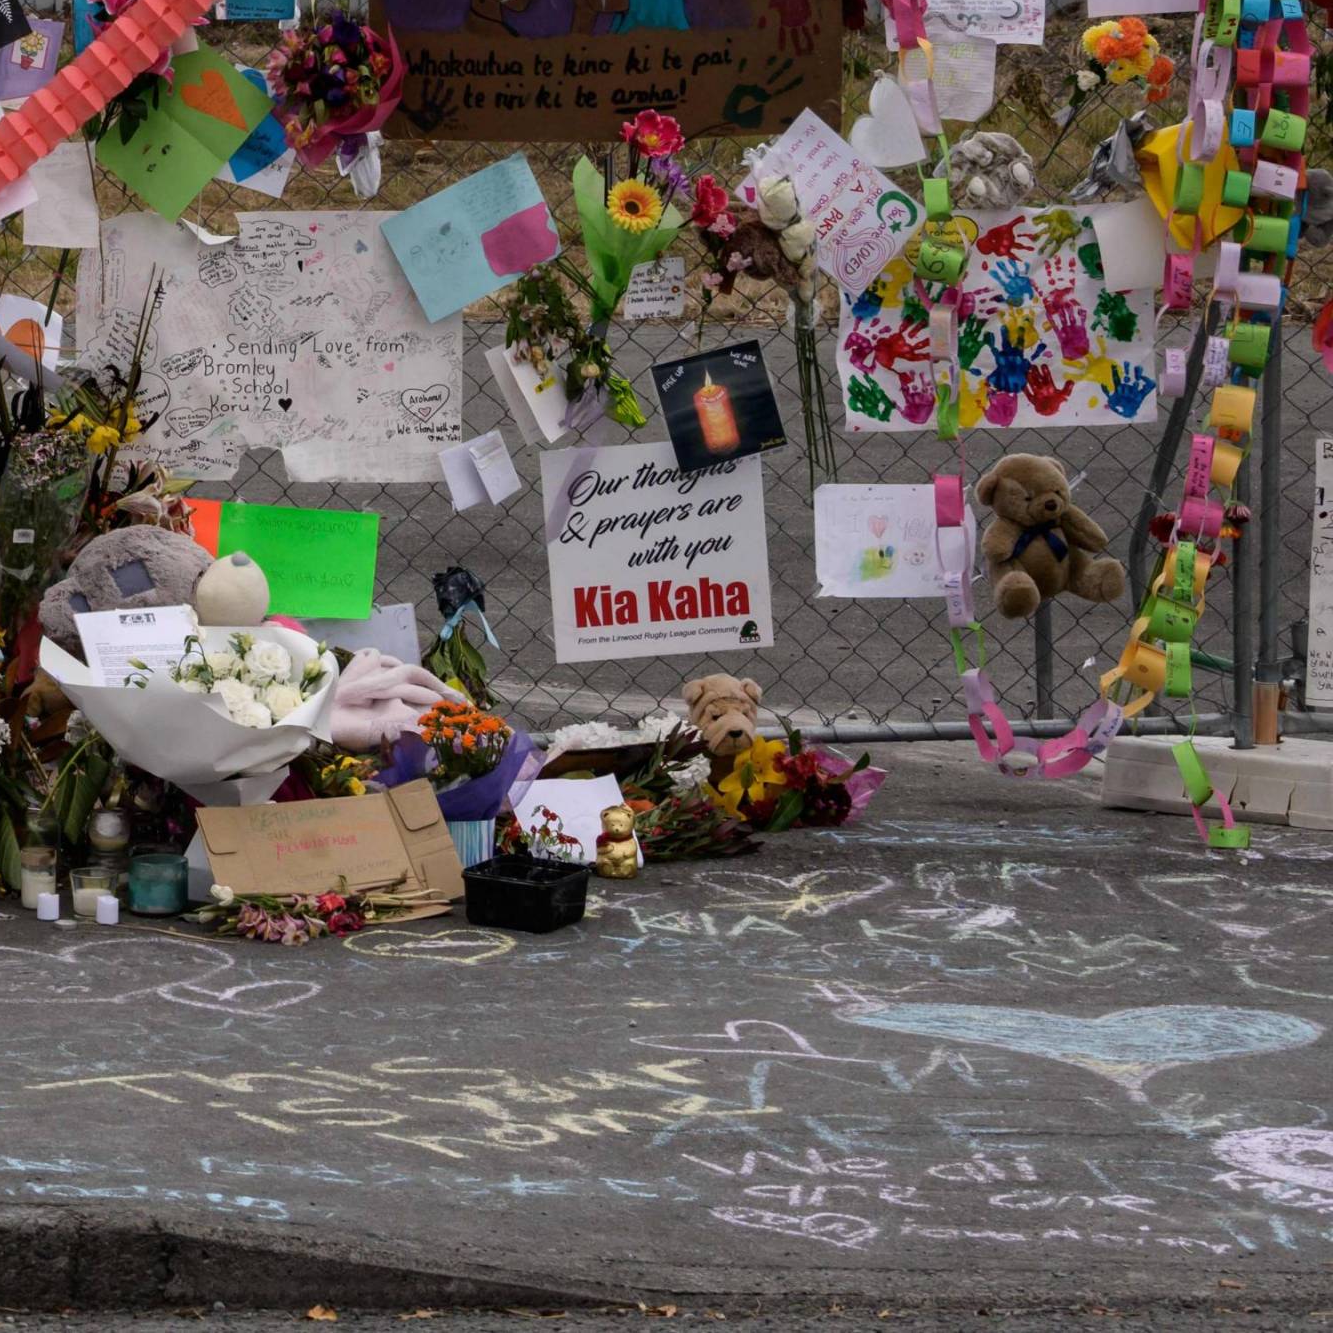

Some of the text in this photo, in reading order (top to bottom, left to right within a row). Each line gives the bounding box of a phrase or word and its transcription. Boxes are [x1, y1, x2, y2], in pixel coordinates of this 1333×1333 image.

[406, 50, 524, 79] Whakautua
[534, 54, 553, 77] te
[563, 47, 613, 76] kino
[626, 45, 651, 75] ki
[661, 48, 683, 72] te
[463, 87, 485, 110] te
[536, 81, 562, 109] ki
[575, 85, 597, 109] te
[612, 78, 687, 106] aroha!
[832, 172, 849, 188] our
[815, 179, 865, 241] A PART
[865, 187, 884, 207] and
[833, 229, 849, 247] are
[845, 206, 906, 275] You are LOVED
[226, 333, 405, 361] Sending Love from
[742, 354, 757, 363] ARE
[204, 356, 276, 385] Bromley
[662, 366, 685, 392] RISE UP
[233, 378, 289, 394] School
[210, 395, 271, 412] Koru 2
[397, 424, 411, 435] We
[568, 470, 630, 507] Our
[560, 494, 743, 549] & prayers are
[628, 534, 735, 570] with you
[574, 577, 751, 628] Kia Kaha
[578, 624, 740, 645] From the Linwood Rugby League Community
[632, 911, 1181, 954] KIA KAHA
[680, 1147, 1041, 1183] We all
[741, 1183, 1161, 1216] are one
